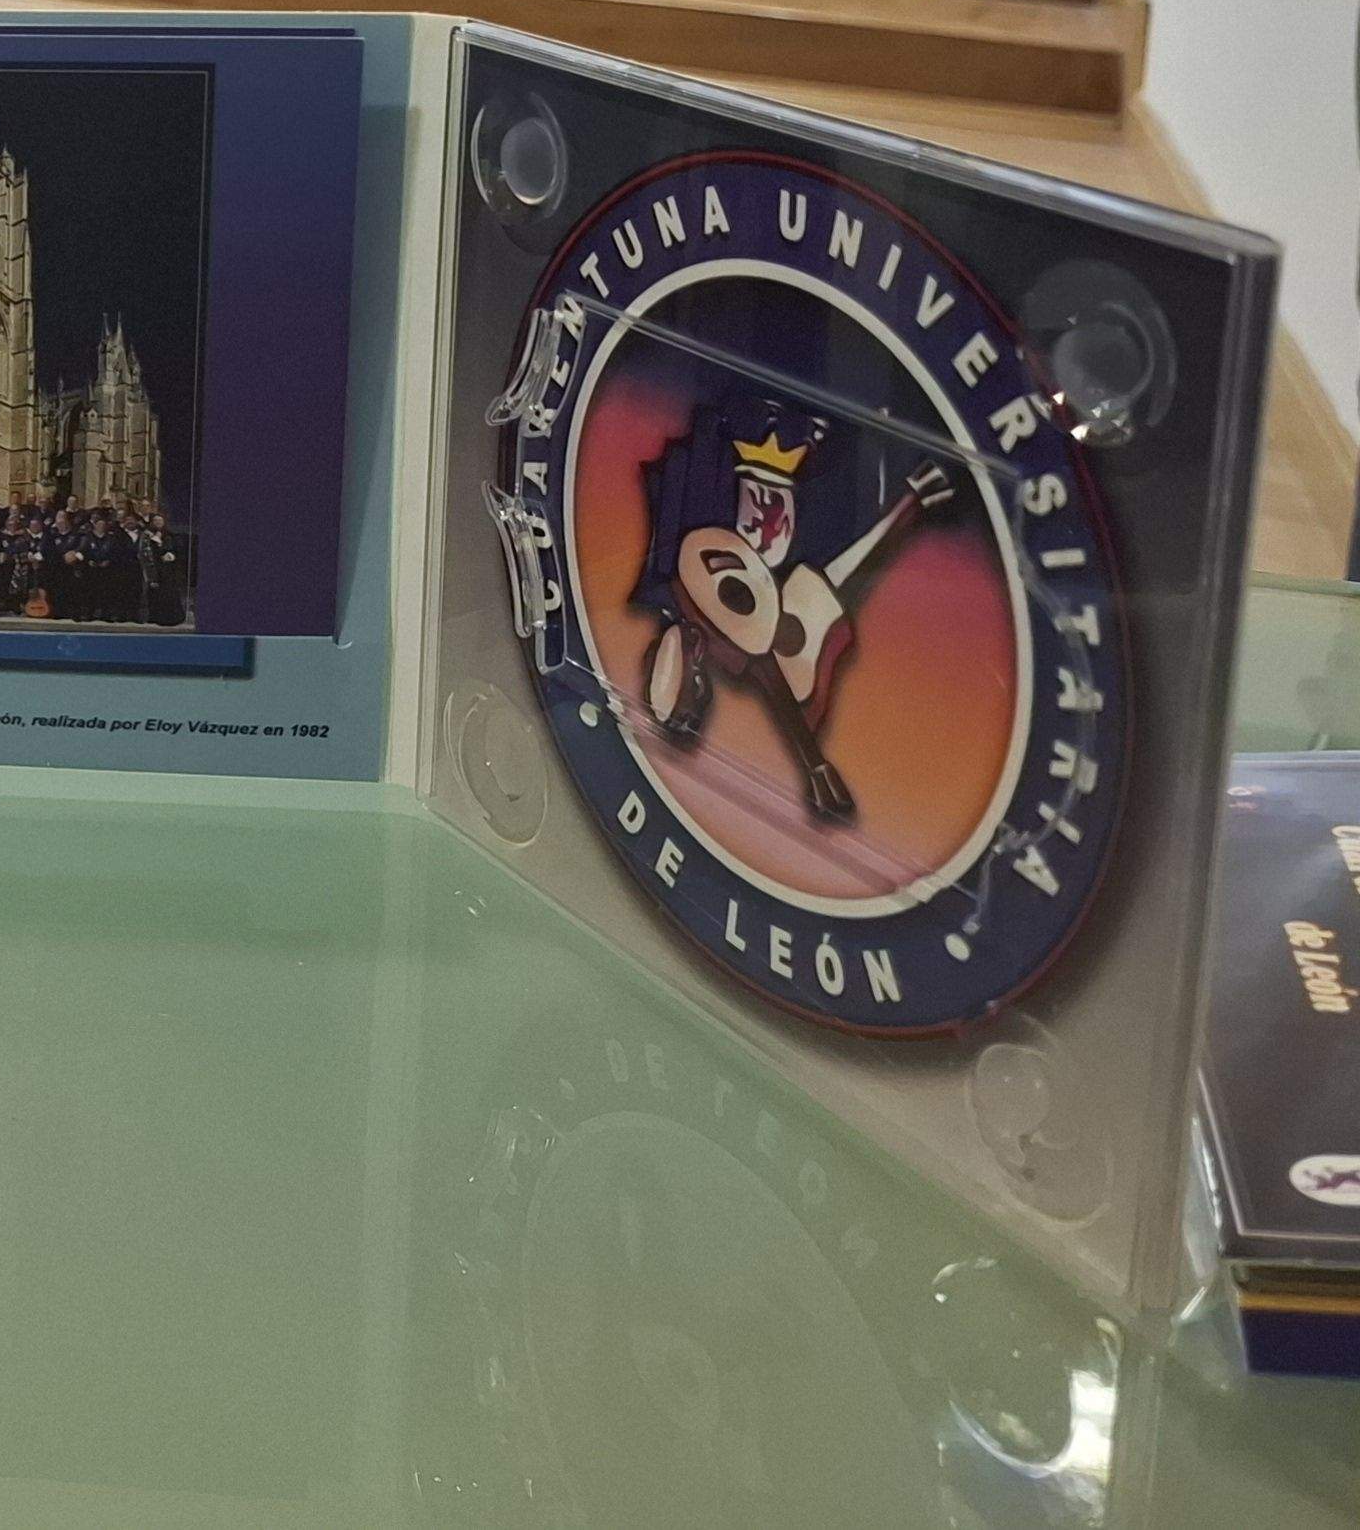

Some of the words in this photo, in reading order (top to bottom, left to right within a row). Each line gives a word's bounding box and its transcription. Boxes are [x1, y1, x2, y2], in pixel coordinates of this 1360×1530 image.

[778, 189, 1105, 897] UNIVERSITARIA
[31, 715, 106, 730] realizada
[109, 719, 141, 733] por
[144, 718, 183, 735] Eloy
[188, 720, 258, 737] Vázquez
[263, 724, 284, 737] en
[291, 724, 330, 738] 1982
[617, 789, 684, 889] DE
[725, 898, 902, 1004] LEÓN
[1283, 921, 1335, 949] de
[1293, 950, 1359, 1013] León
